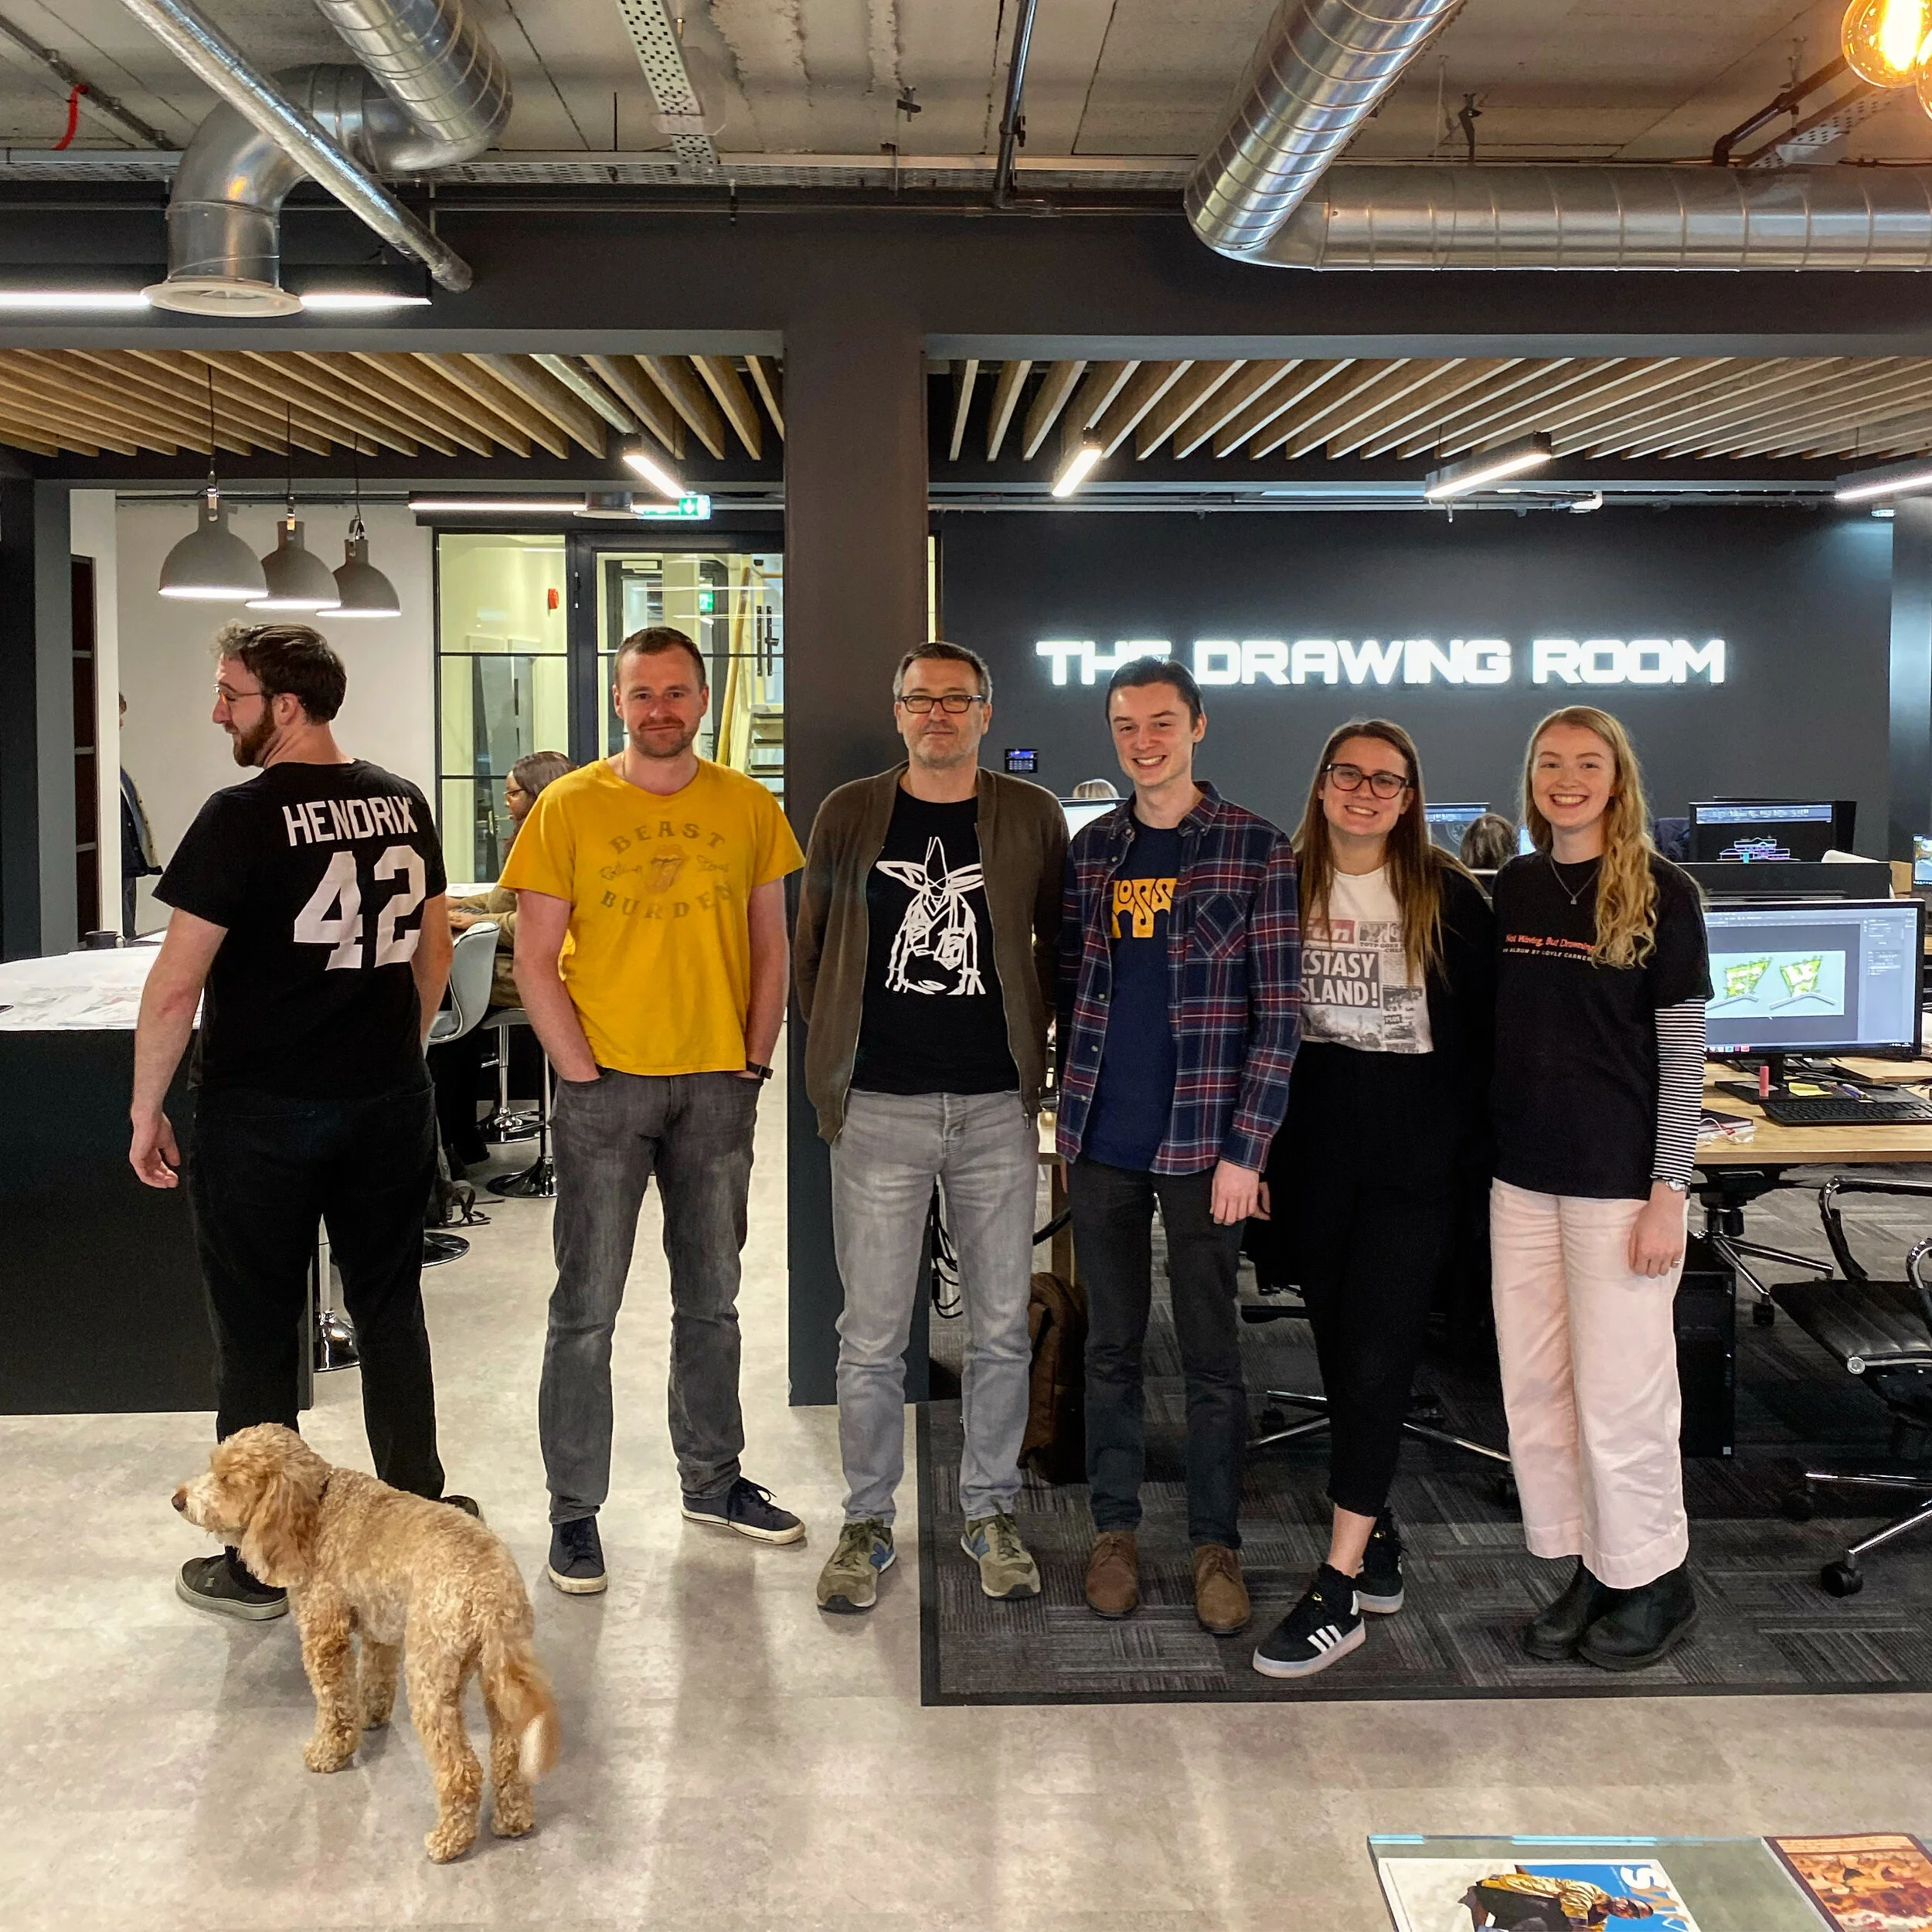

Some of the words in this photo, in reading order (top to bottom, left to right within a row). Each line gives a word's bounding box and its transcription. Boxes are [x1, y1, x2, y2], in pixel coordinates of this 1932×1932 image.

[1194, 639, 1512, 685] DRAWING
[1532, 639, 1725, 685] ROOM
[281, 795, 418, 847] HENDRIX
[608, 821, 726, 855] BEAST
[294, 844, 427, 971] 42
[1301, 949, 1376, 978] CSTASY
[1299, 978, 1379, 1007] SLAND!
